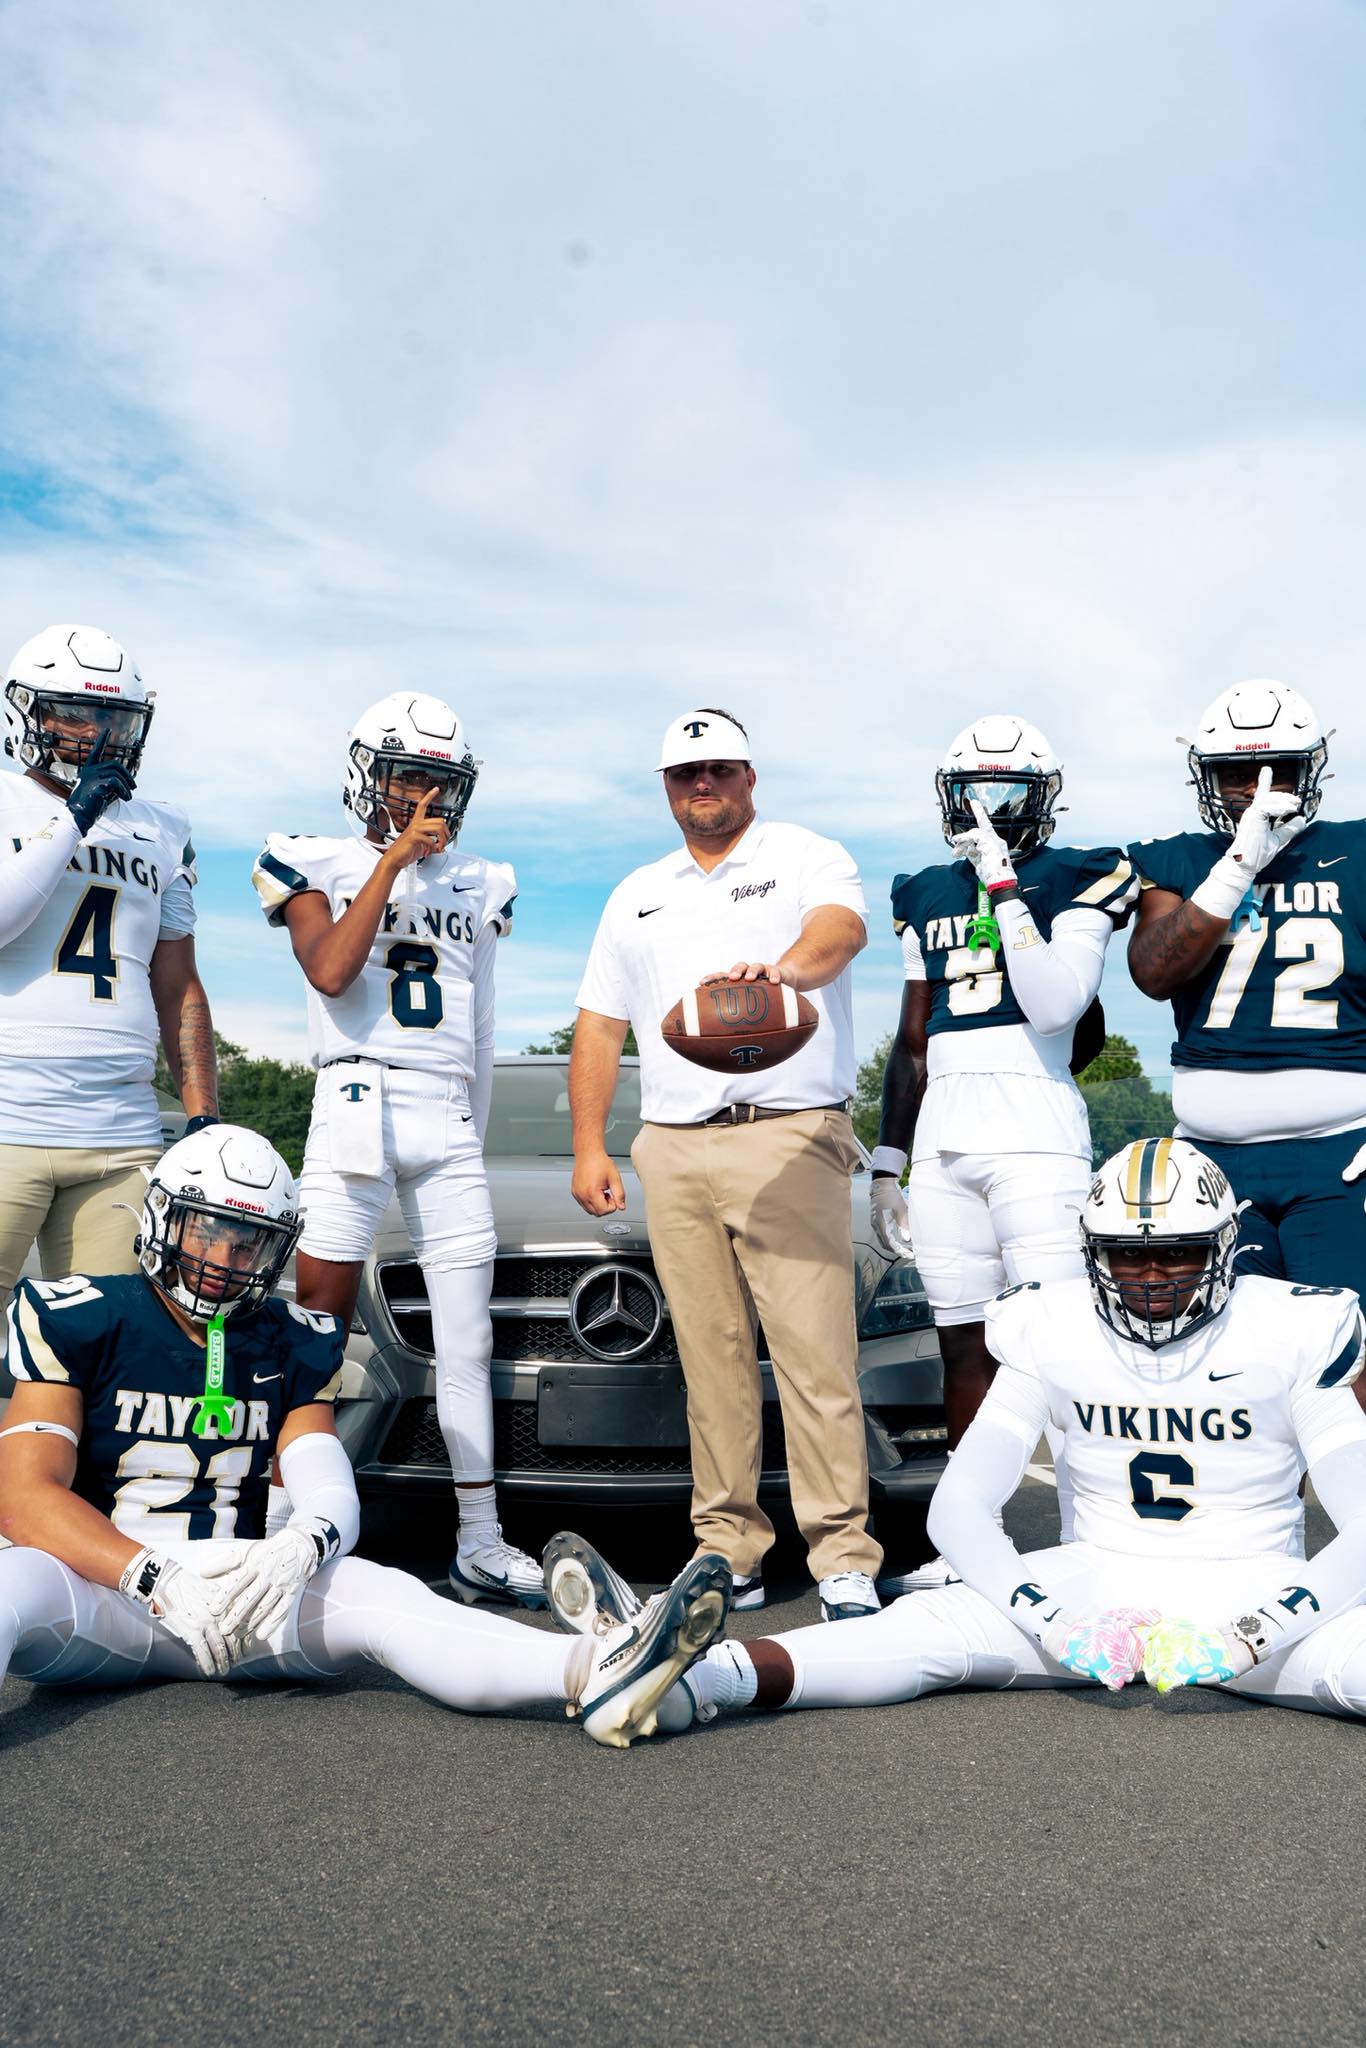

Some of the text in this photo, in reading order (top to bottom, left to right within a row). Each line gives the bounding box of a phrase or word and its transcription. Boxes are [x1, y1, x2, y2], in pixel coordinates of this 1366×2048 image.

[84, 682, 121, 694] Riddell
[683, 721, 710, 739] T
[1234, 742, 1271, 752] Riddell
[731, 879, 777, 903] Vikings
[1252, 881, 1343, 915] YLOR
[52, 880, 122, 1005] 4
[383, 941, 446, 1033] 8
[1202, 916, 1346, 1030] 72
[729, 1045, 764, 1066] T
[339, 1082, 371, 1102] T
[1072, 1400, 1253, 1443] VIKINGS
[110, 1440, 254, 1540] 21
[136, 1559, 162, 1598] NIKE
[1010, 1582, 1049, 1608] T
[1277, 1586, 1321, 1616] T
